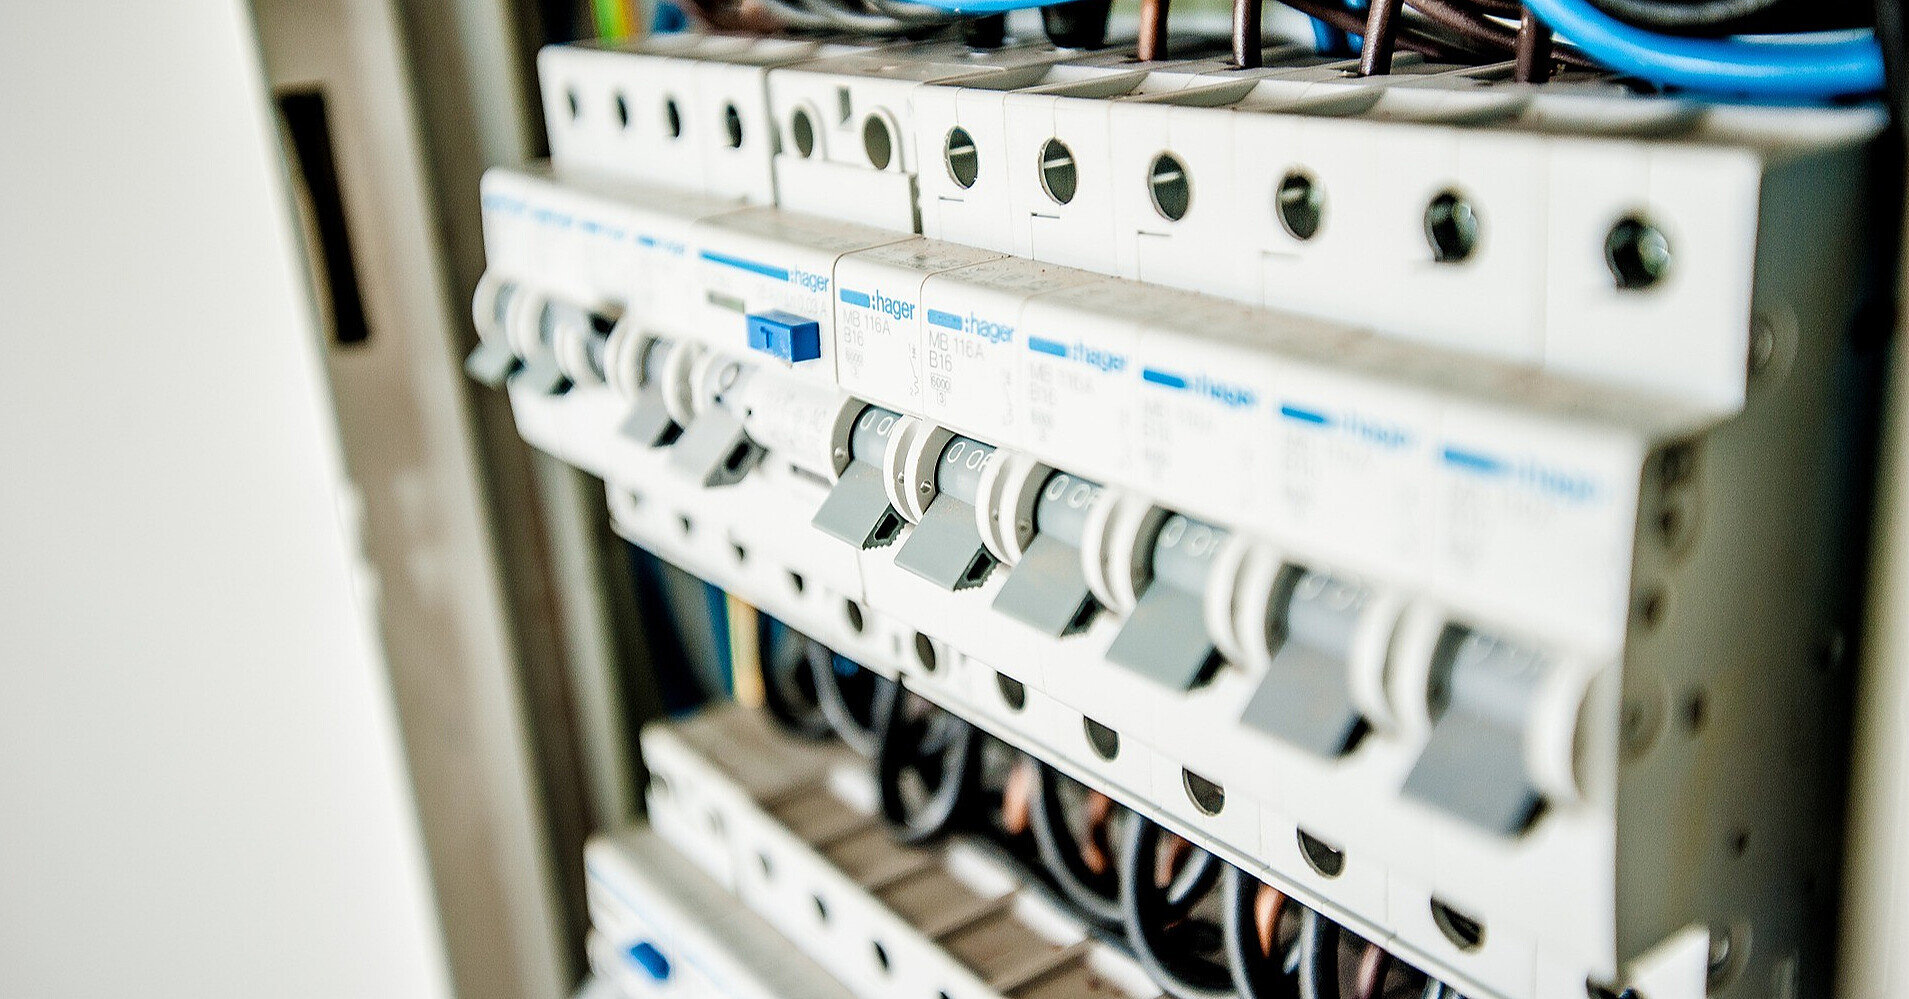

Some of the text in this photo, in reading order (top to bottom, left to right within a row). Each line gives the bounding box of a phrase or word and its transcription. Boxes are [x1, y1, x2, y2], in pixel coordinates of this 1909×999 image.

[843, 310, 891, 335] MB 116A
[843, 326, 864, 347] B16
[929, 329, 984, 360] MB 116A
[929, 349, 953, 372] B16
